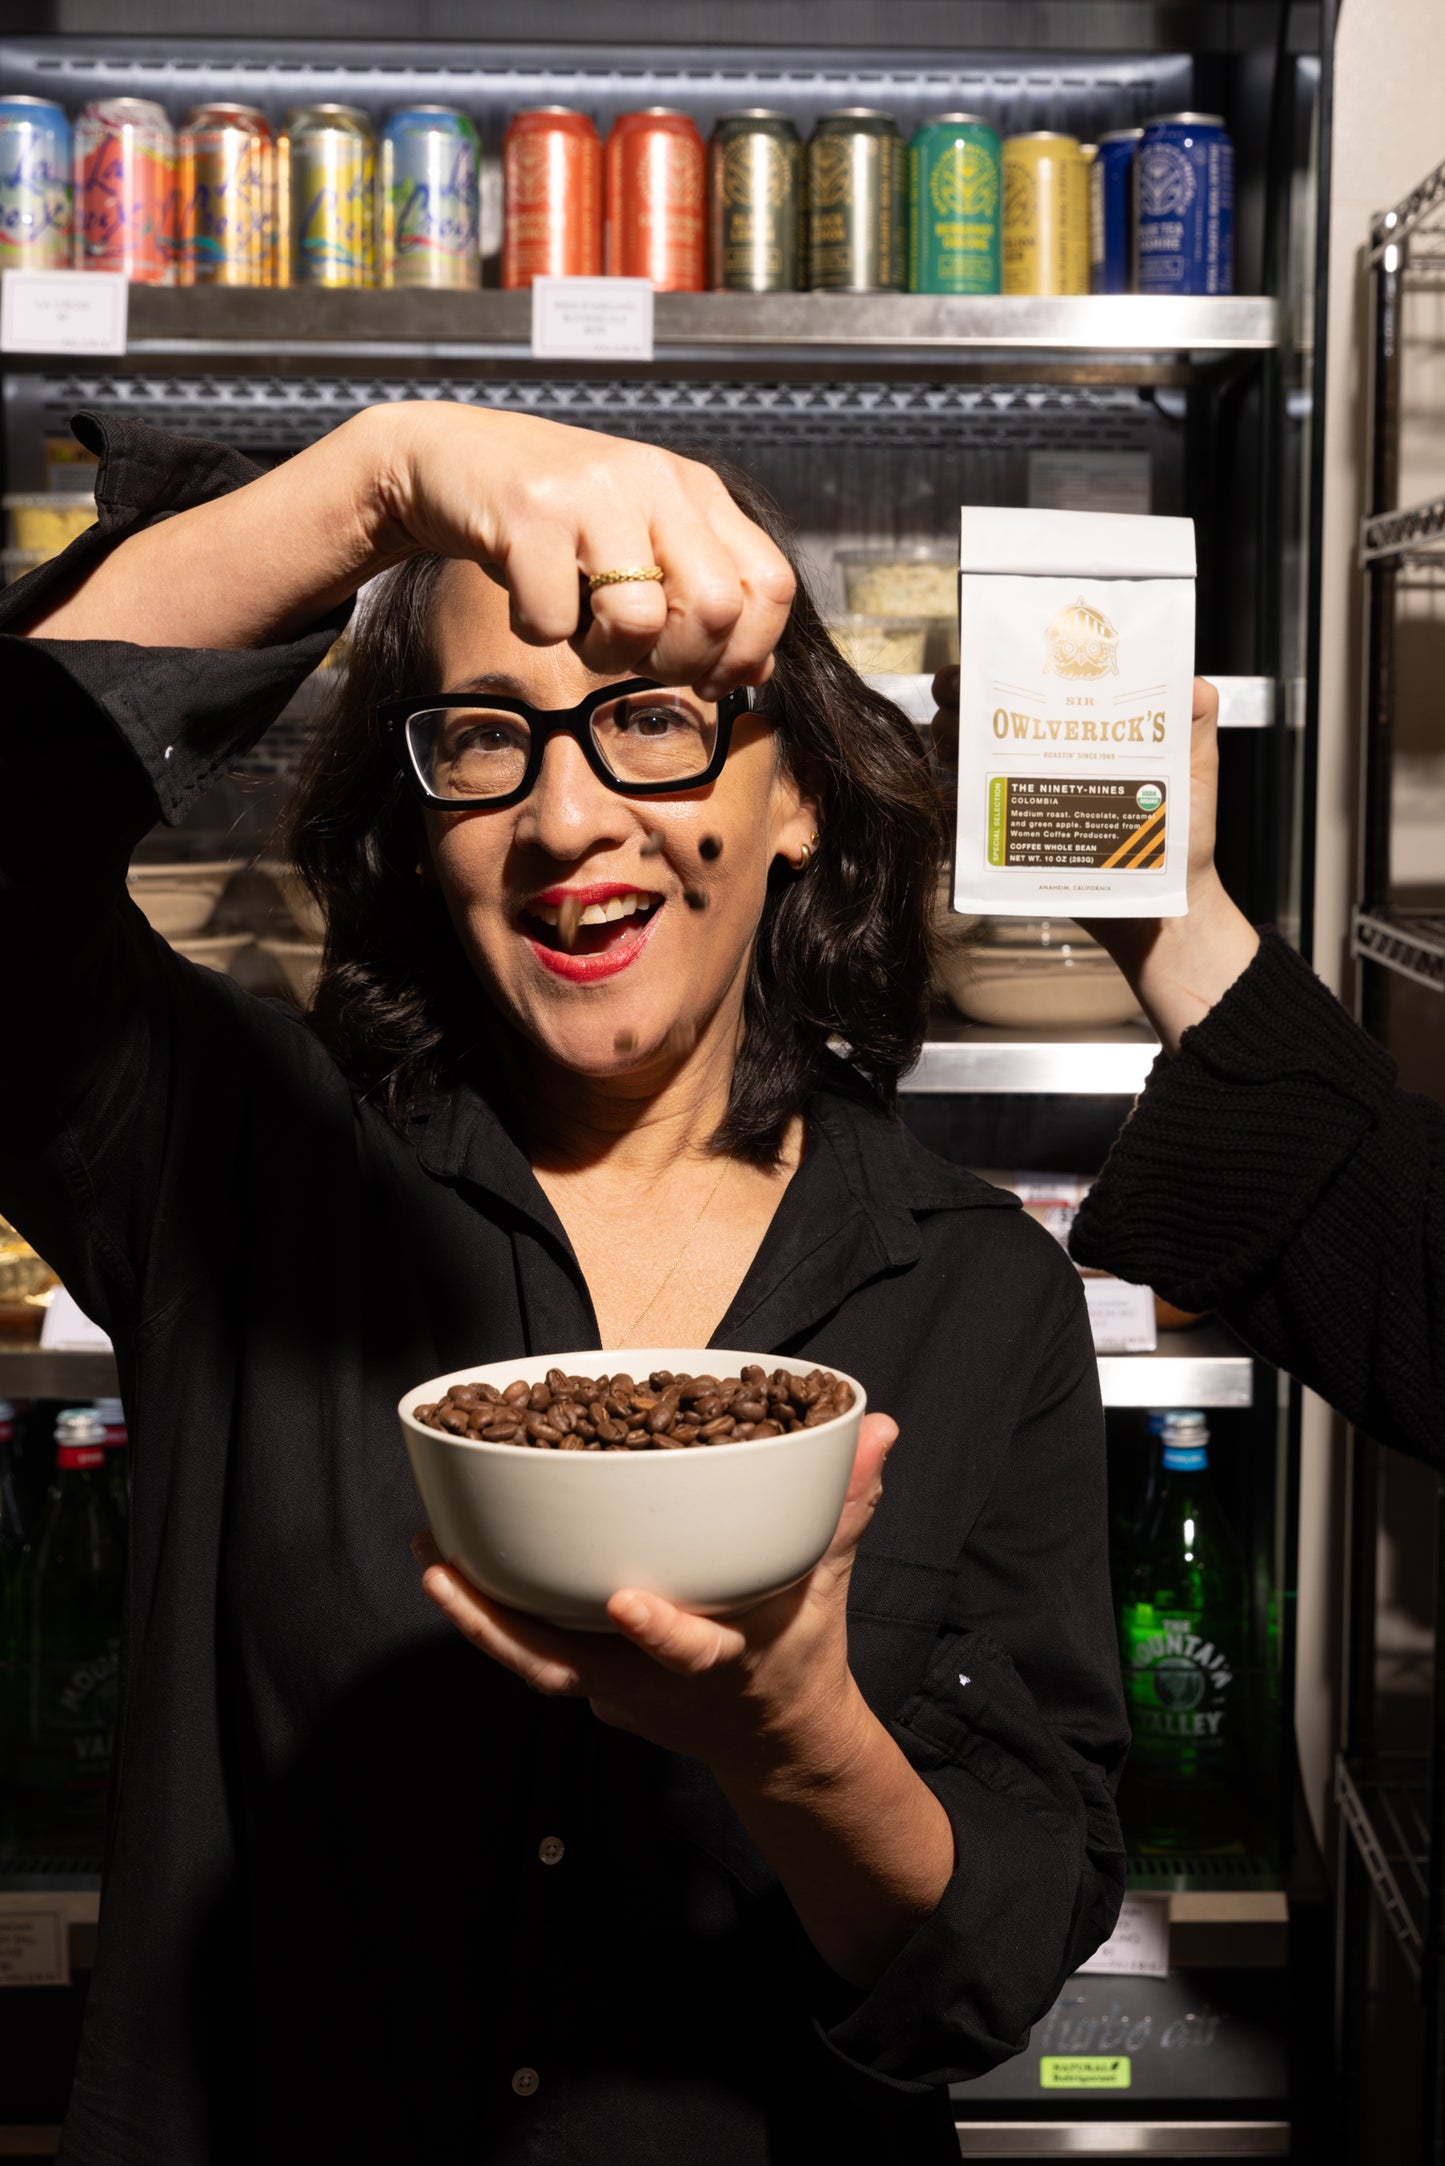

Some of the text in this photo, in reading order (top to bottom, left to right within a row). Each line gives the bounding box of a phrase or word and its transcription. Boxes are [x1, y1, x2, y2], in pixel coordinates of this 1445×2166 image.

[1066, 696, 1095, 706] SIR
[993, 708, 1166, 743] OWLVERICK'S
[1078, 752, 1097, 760] SINCE
[1011, 783, 1125, 795] THE NINETY-NINES
[1011, 797, 1059, 805] COLOMBIA
[1011, 810, 1044, 818] Medium
[1046, 811, 1071, 819] roast.
[1074, 811, 1119, 821] Chocolate,
[993, 783, 1001, 862] SPECIAL SELECTION
[1010, 820, 1141, 830] and green apple. Sourced from
[1010, 830, 1119, 839] Women Coffee Producers.
[1044, 843, 1073, 851] WHOLE
[1075, 844, 1097, 852] BEAN
[1028, 855, 1042, 863] WT.
[1044, 855, 1054, 863] 10
[1056, 855, 1067, 863] OZ
[1069, 855, 1095, 864] (283G)
[1038, 884, 1071, 892] ANAHEIM,
[1162, 1619, 1191, 1632] THE
[1131, 1632, 1234, 1691] OUNTAIN
